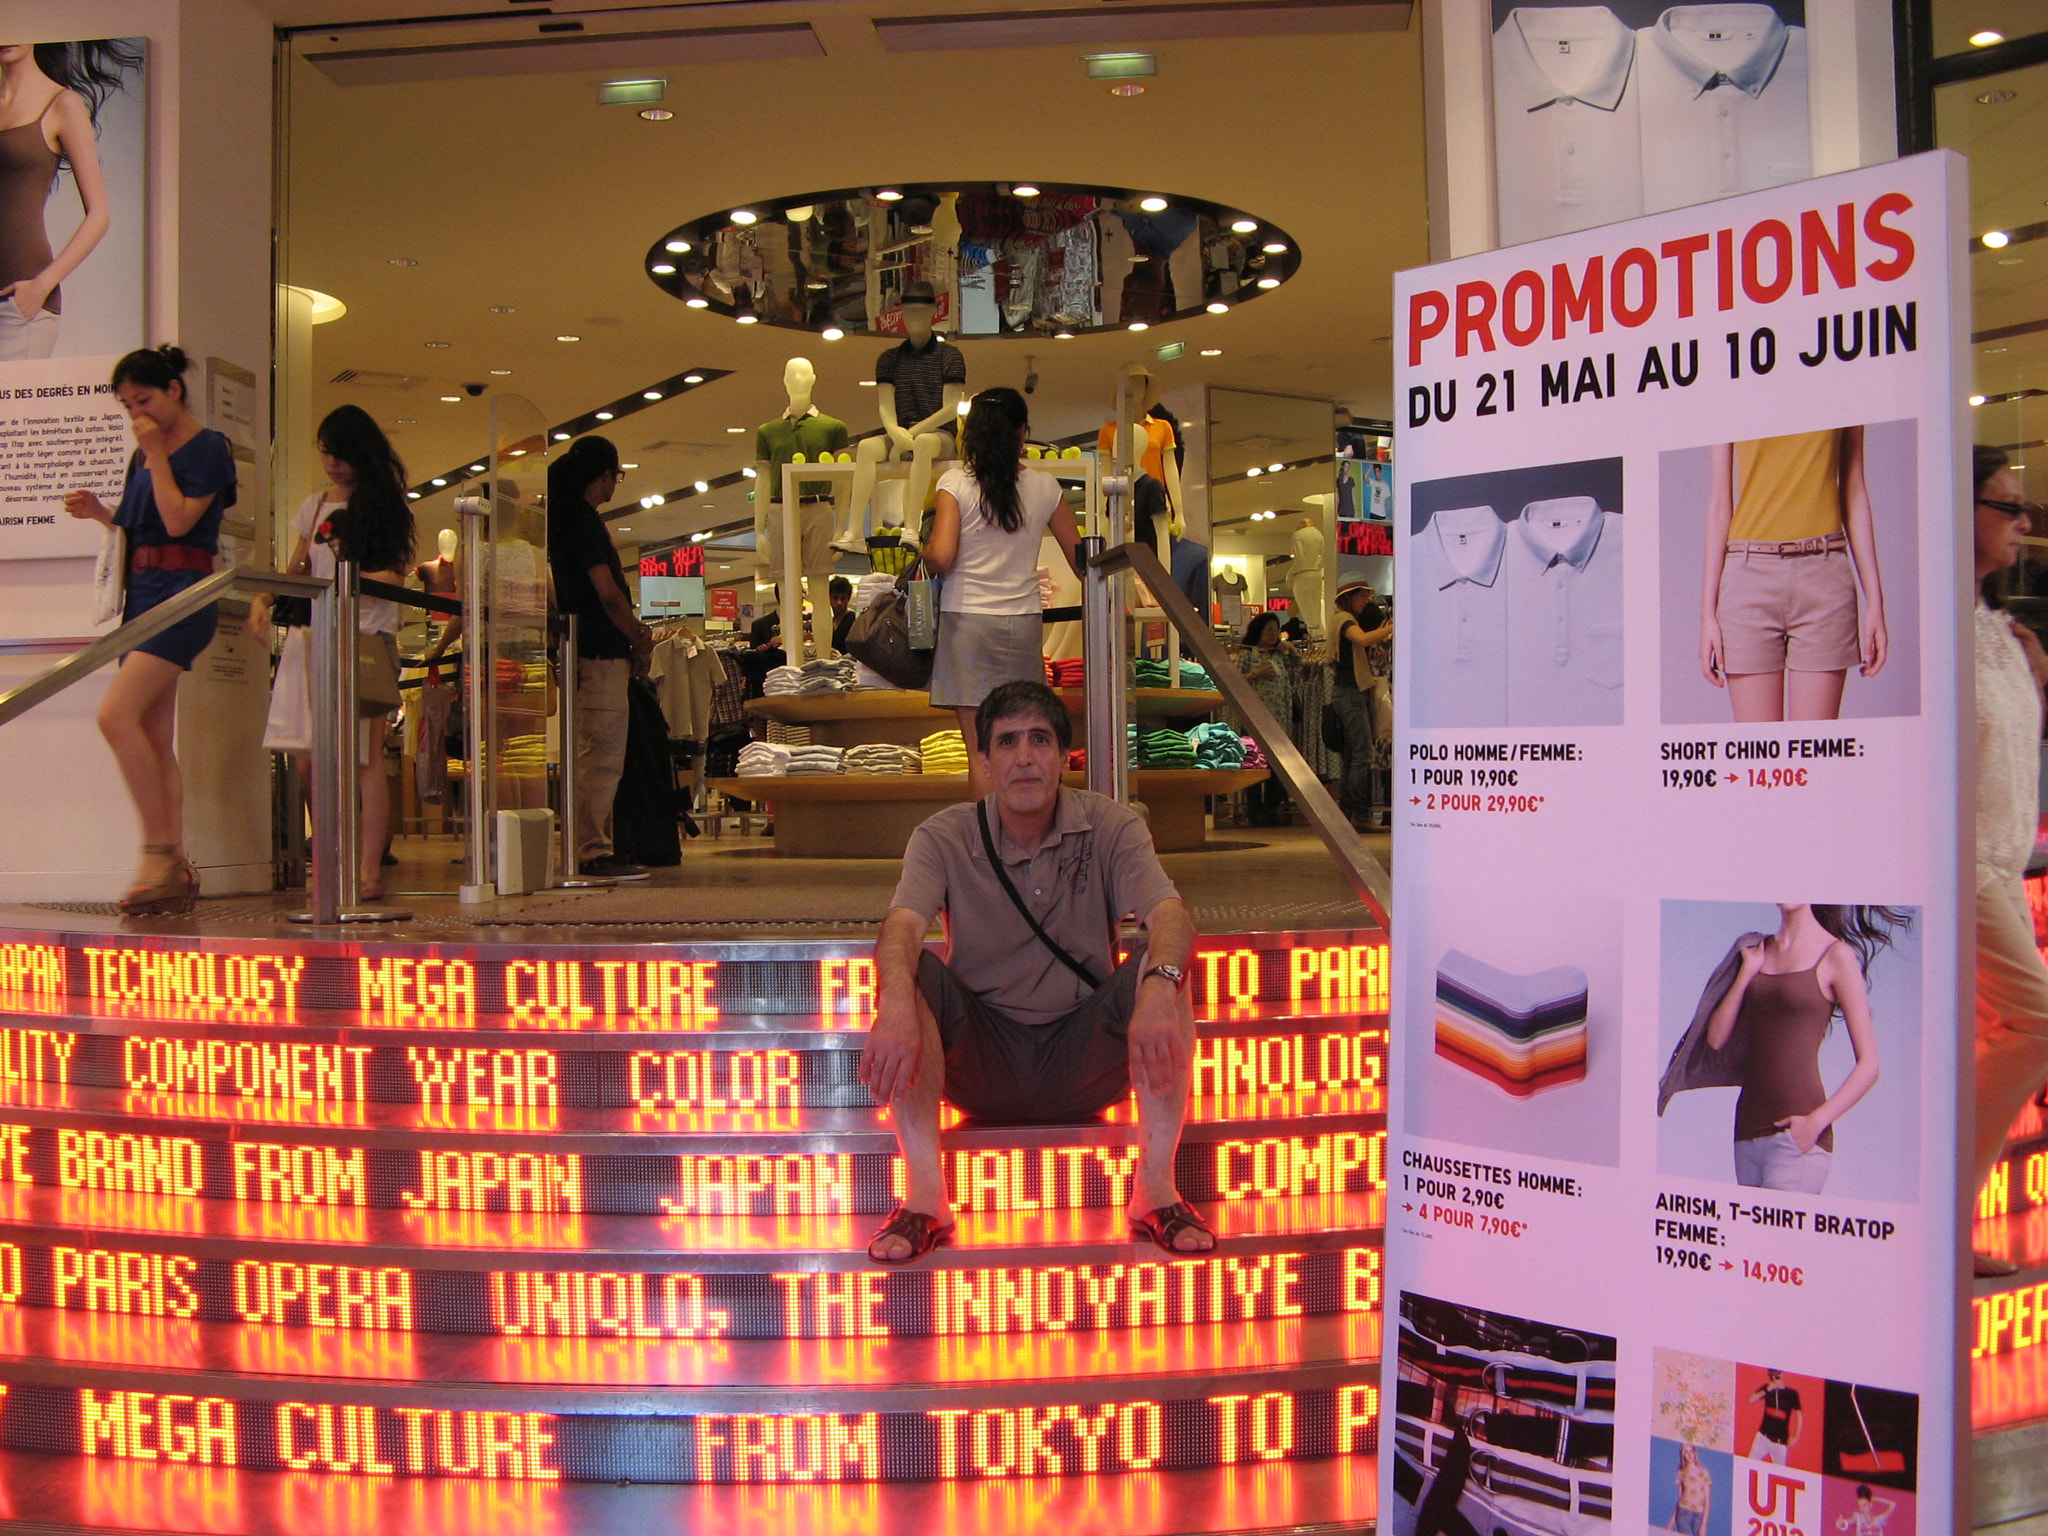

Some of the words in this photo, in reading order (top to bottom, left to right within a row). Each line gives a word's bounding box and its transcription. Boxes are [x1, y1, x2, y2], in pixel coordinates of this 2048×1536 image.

[1408, 192, 1916, 367] PROMOTIONS
[1408, 379, 1456, 428] DU
[1475, 369, 1515, 417] 21
[1541, 352, 1616, 407] MAI
[1637, 339, 1699, 393] AU
[1726, 327, 1776, 379] 10
[1798, 301, 1917, 367] JUIN
[15, 389, 33, 399] DES
[37, 384, 74, 398] DEGRÉS
[78, 385, 90, 396] EN
[11, 418, 19, 426] de
[30, 428, 39, 436] les
[57, 449, 81, 457] comme
[110, 446, 124, 454] bien
[78, 458, 86, 466] de
[43, 471, 56, 479] tout
[27, 515, 56, 525] FEMME
[1409, 744, 1448, 761] POLO
[1660, 741, 1718, 760] SHORT
[1725, 740, 1781, 759] CHINO
[1788, 738, 1865, 759] FEMME:
[1411, 768, 1416, 785] 1
[1424, 769, 1463, 786] POUR
[1471, 769, 1518, 789] 19,90€
[1661, 769, 1717, 790] 19,90€
[1747, 768, 1808, 790] 14,90€
[1426, 794, 1436, 810] 2
[1441, 794, 1481, 812] POUR
[83, 947, 304, 1008] TECHNOLOGY
[358, 957, 475, 1012] MEGA
[505, 959, 718, 1015] CULTURE
[1197, 949, 1258, 1004] TO
[124, 1035, 372, 1101] COMPONENT
[629, 1049, 799, 1108] COLOR
[1193, 1030, 1389, 1096] HNOLOG
[58, 1128, 203, 1197] BRAND
[234, 1142, 366, 1206] FROM
[402, 1151, 582, 1213] JAPAN
[661, 1152, 852, 1215] JAPAN
[1402, 1150, 1512, 1186] CHAUSSETTES
[1518, 1171, 1583, 1197] HOMME:
[1403, 1174, 1409, 1191] 1
[1416, 1178, 1456, 1201] POUR
[1462, 1187, 1504, 1210] 2,90€
[1419, 1203, 1428, 1220] 4
[1434, 1206, 1474, 1230] POUR
[1655, 1192, 1721, 1221] AIRISM,
[1729, 1202, 1806, 1230] T-SHIRT
[1814, 1214, 1895, 1240] BRATOP
[1655, 1219, 1726, 1247] FEMME:
[1656, 1245, 1712, 1271] 19,90€
[1743, 1259, 1804, 1287] 14,90€
[54, 1246, 198, 1318] PARIS
[233, 1259, 412, 1330] OPERA
[772, 1271, 889, 1337] THE
[1344, 1247, 1380, 1312] B
[81, 1387, 236, 1465] MEGA
[278, 1401, 560, 1480] CULTURE
[696, 1411, 879, 1481] FROM
[926, 1400, 1162, 1478] TOKYO
[1208, 1392, 1293, 1463] TO
[1338, 1384, 1377, 1453] P
[1749, 1468, 1806, 1524] UT
